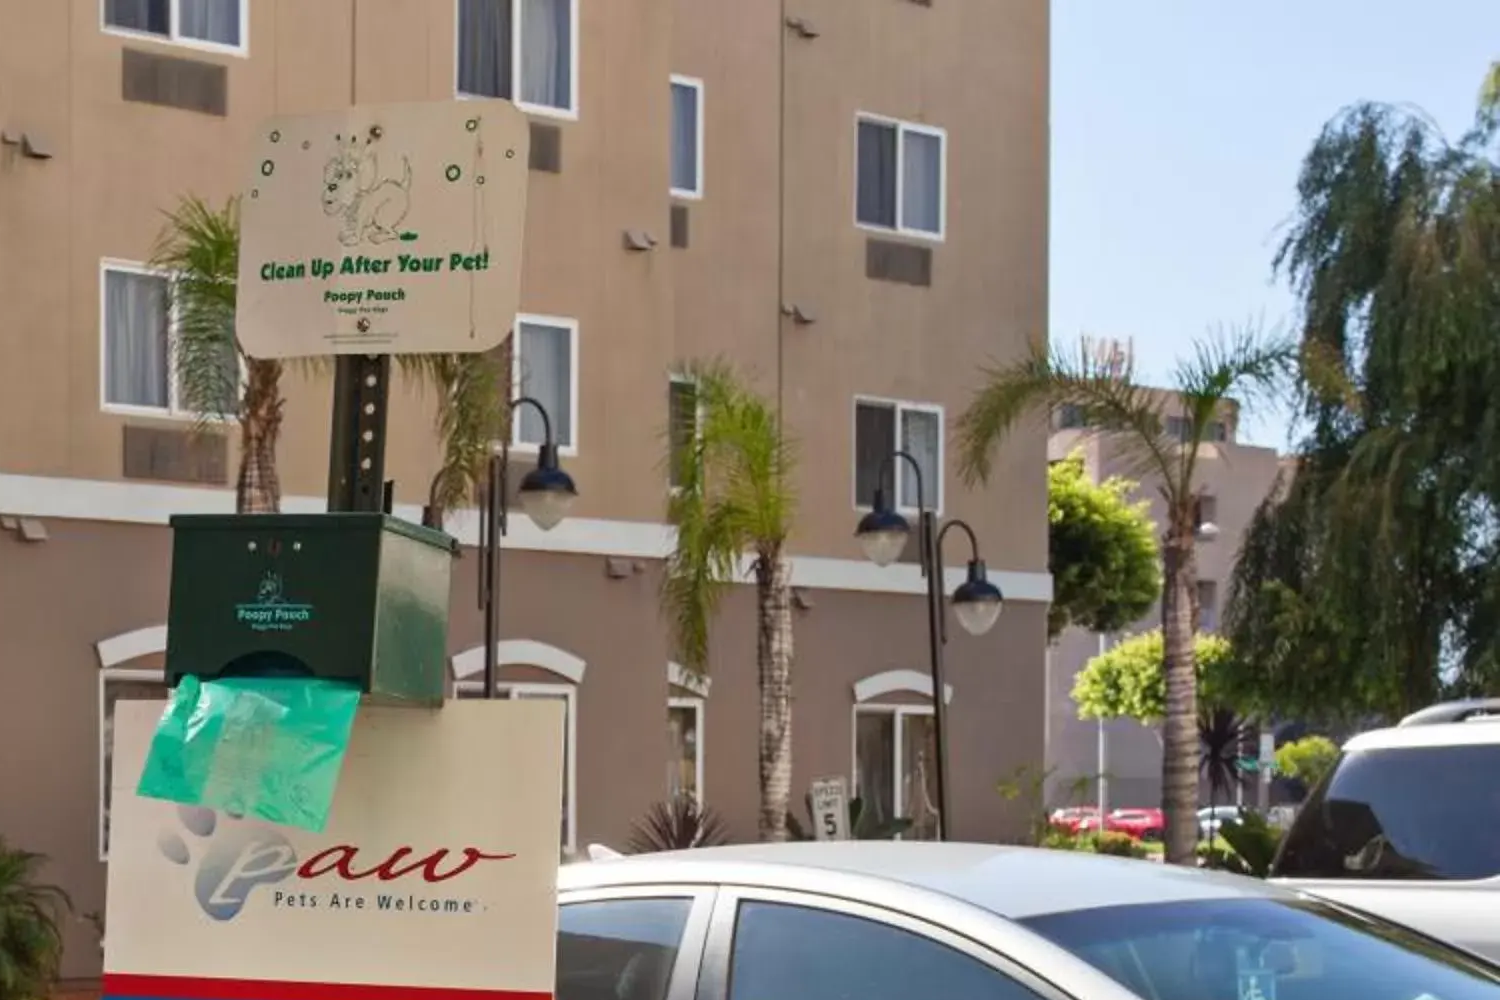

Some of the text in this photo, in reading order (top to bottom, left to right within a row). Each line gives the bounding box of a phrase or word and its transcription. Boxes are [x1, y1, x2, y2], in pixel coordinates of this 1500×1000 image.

[261, 250, 489, 281] Clean Up After Your Pet!
[323, 287, 405, 304] Poopy Pouch
[237, 609, 309, 622] Poopy Pouch
[823, 813, 837, 836] 5
[274, 891, 474, 912] Pets Are Welcome
